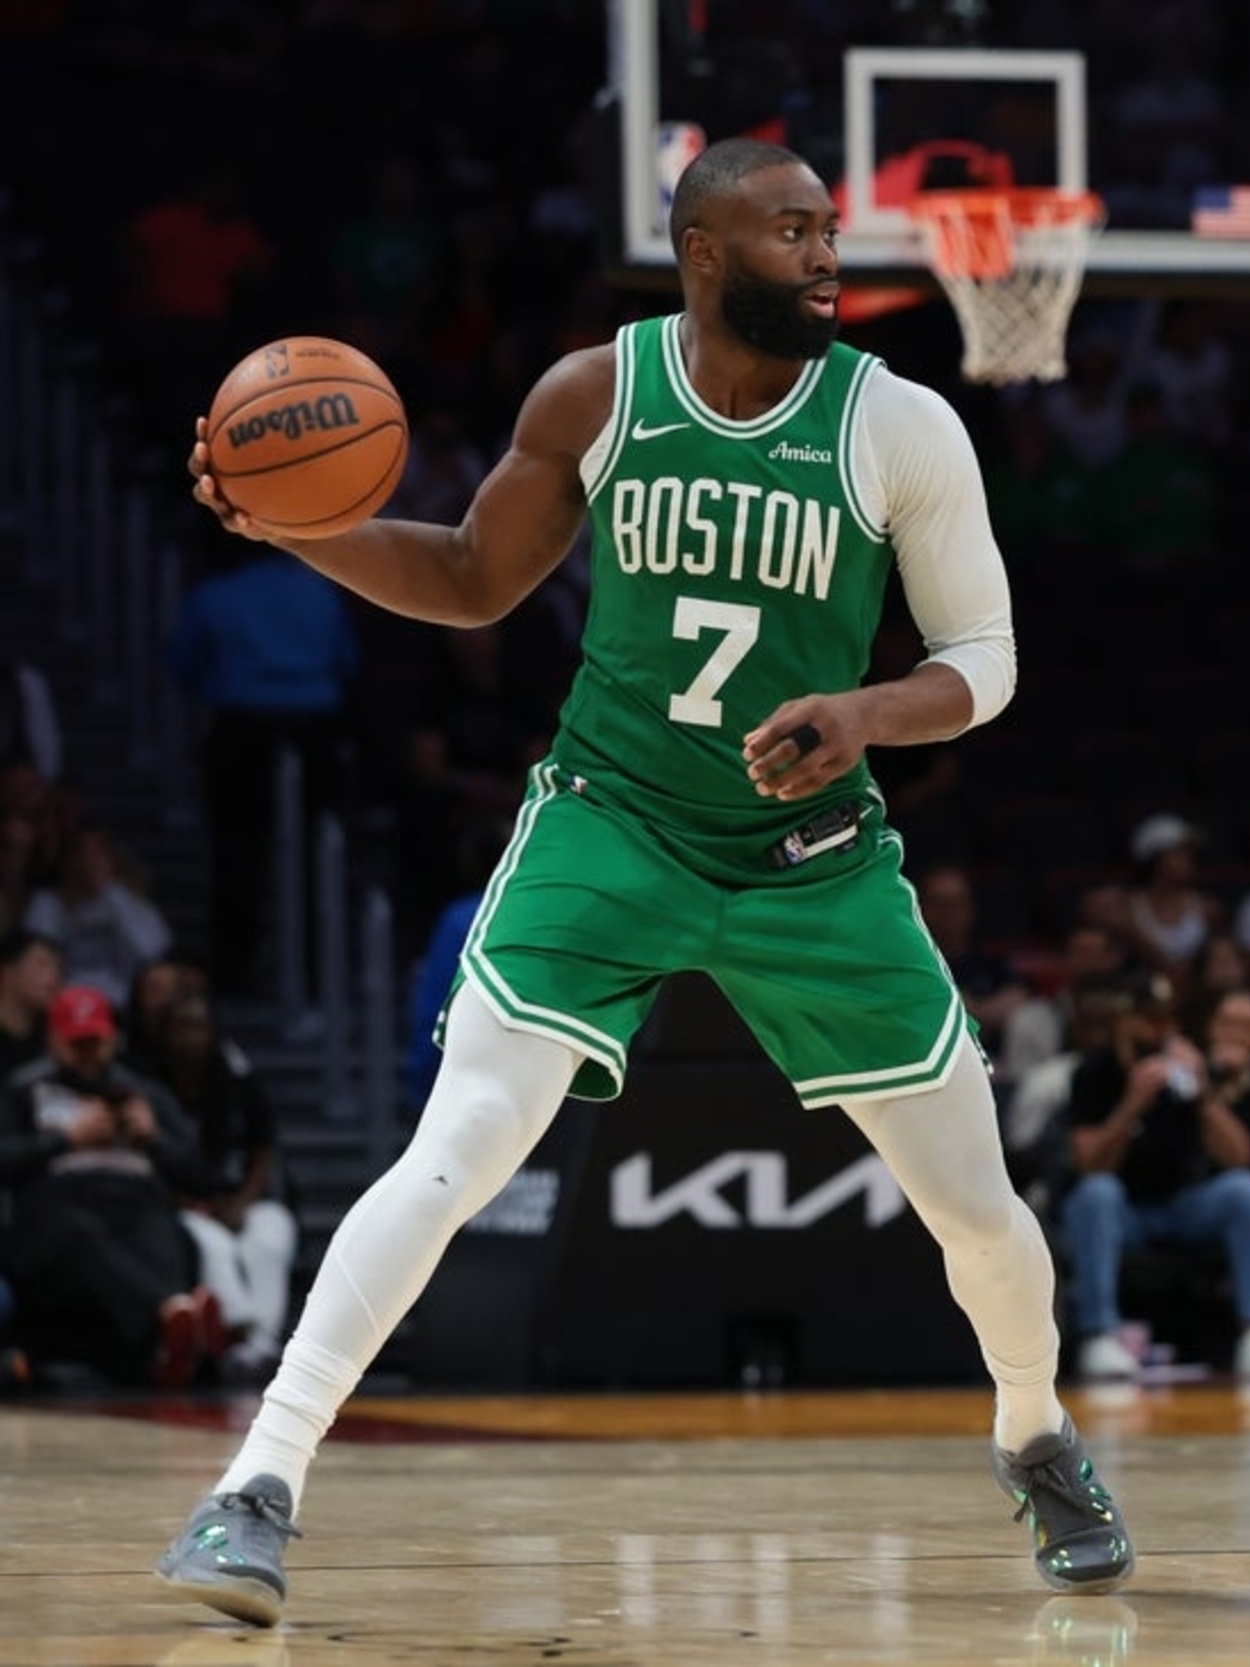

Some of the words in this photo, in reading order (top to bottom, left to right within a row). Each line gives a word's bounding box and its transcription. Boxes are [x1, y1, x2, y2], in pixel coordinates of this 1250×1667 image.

[226, 392, 359, 449] Wilson
[768, 440, 832, 464] Amica
[612, 477, 841, 600] BOSTON
[668, 596, 761, 727] 7
